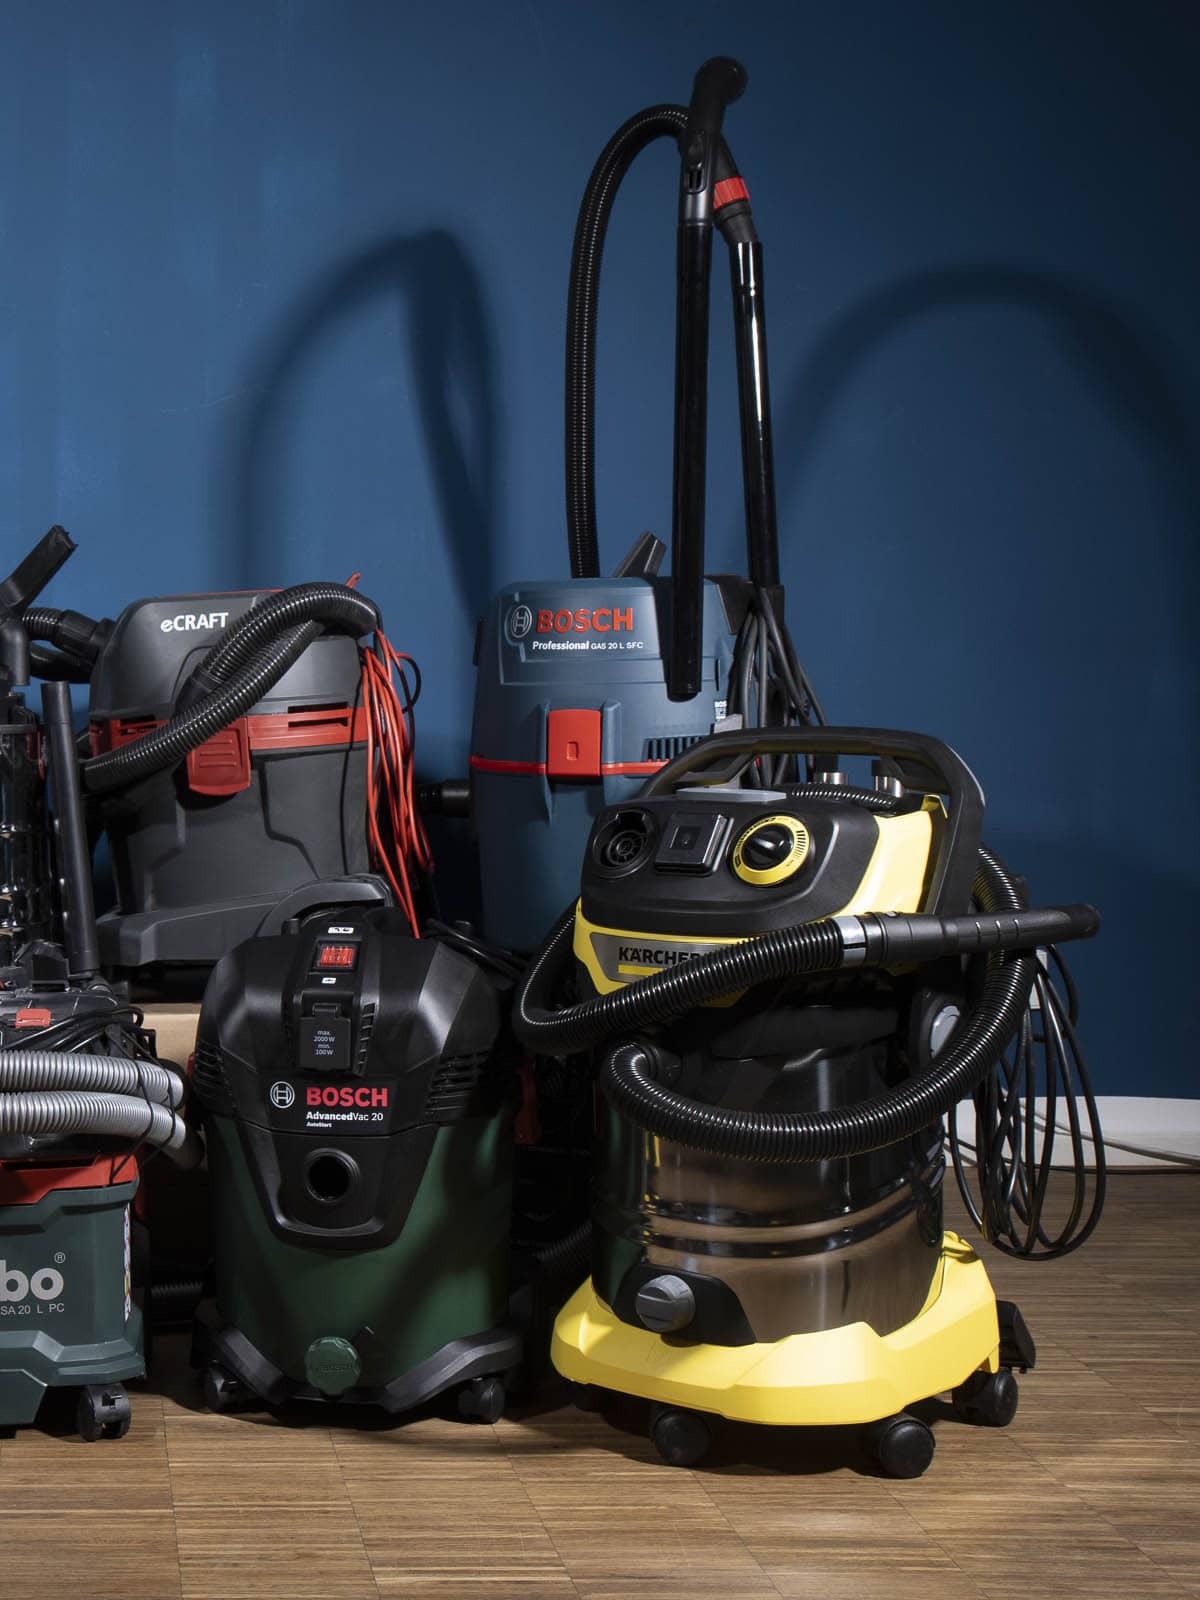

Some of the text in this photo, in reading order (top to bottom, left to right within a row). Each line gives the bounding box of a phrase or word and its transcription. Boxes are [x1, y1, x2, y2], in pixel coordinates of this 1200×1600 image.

[160, 612, 229, 633] eCRAFT
[537, 607, 634, 634] BOSCH
[532, 640, 590, 650] Professional
[306, 1086, 389, 1108] BOSCH
[305, 1111, 383, 1121] AdvancedVac 20
[17, 1304, 31, 1315] 20
[36, 1304, 44, 1314] L
[48, 1302, 65, 1313] PC
